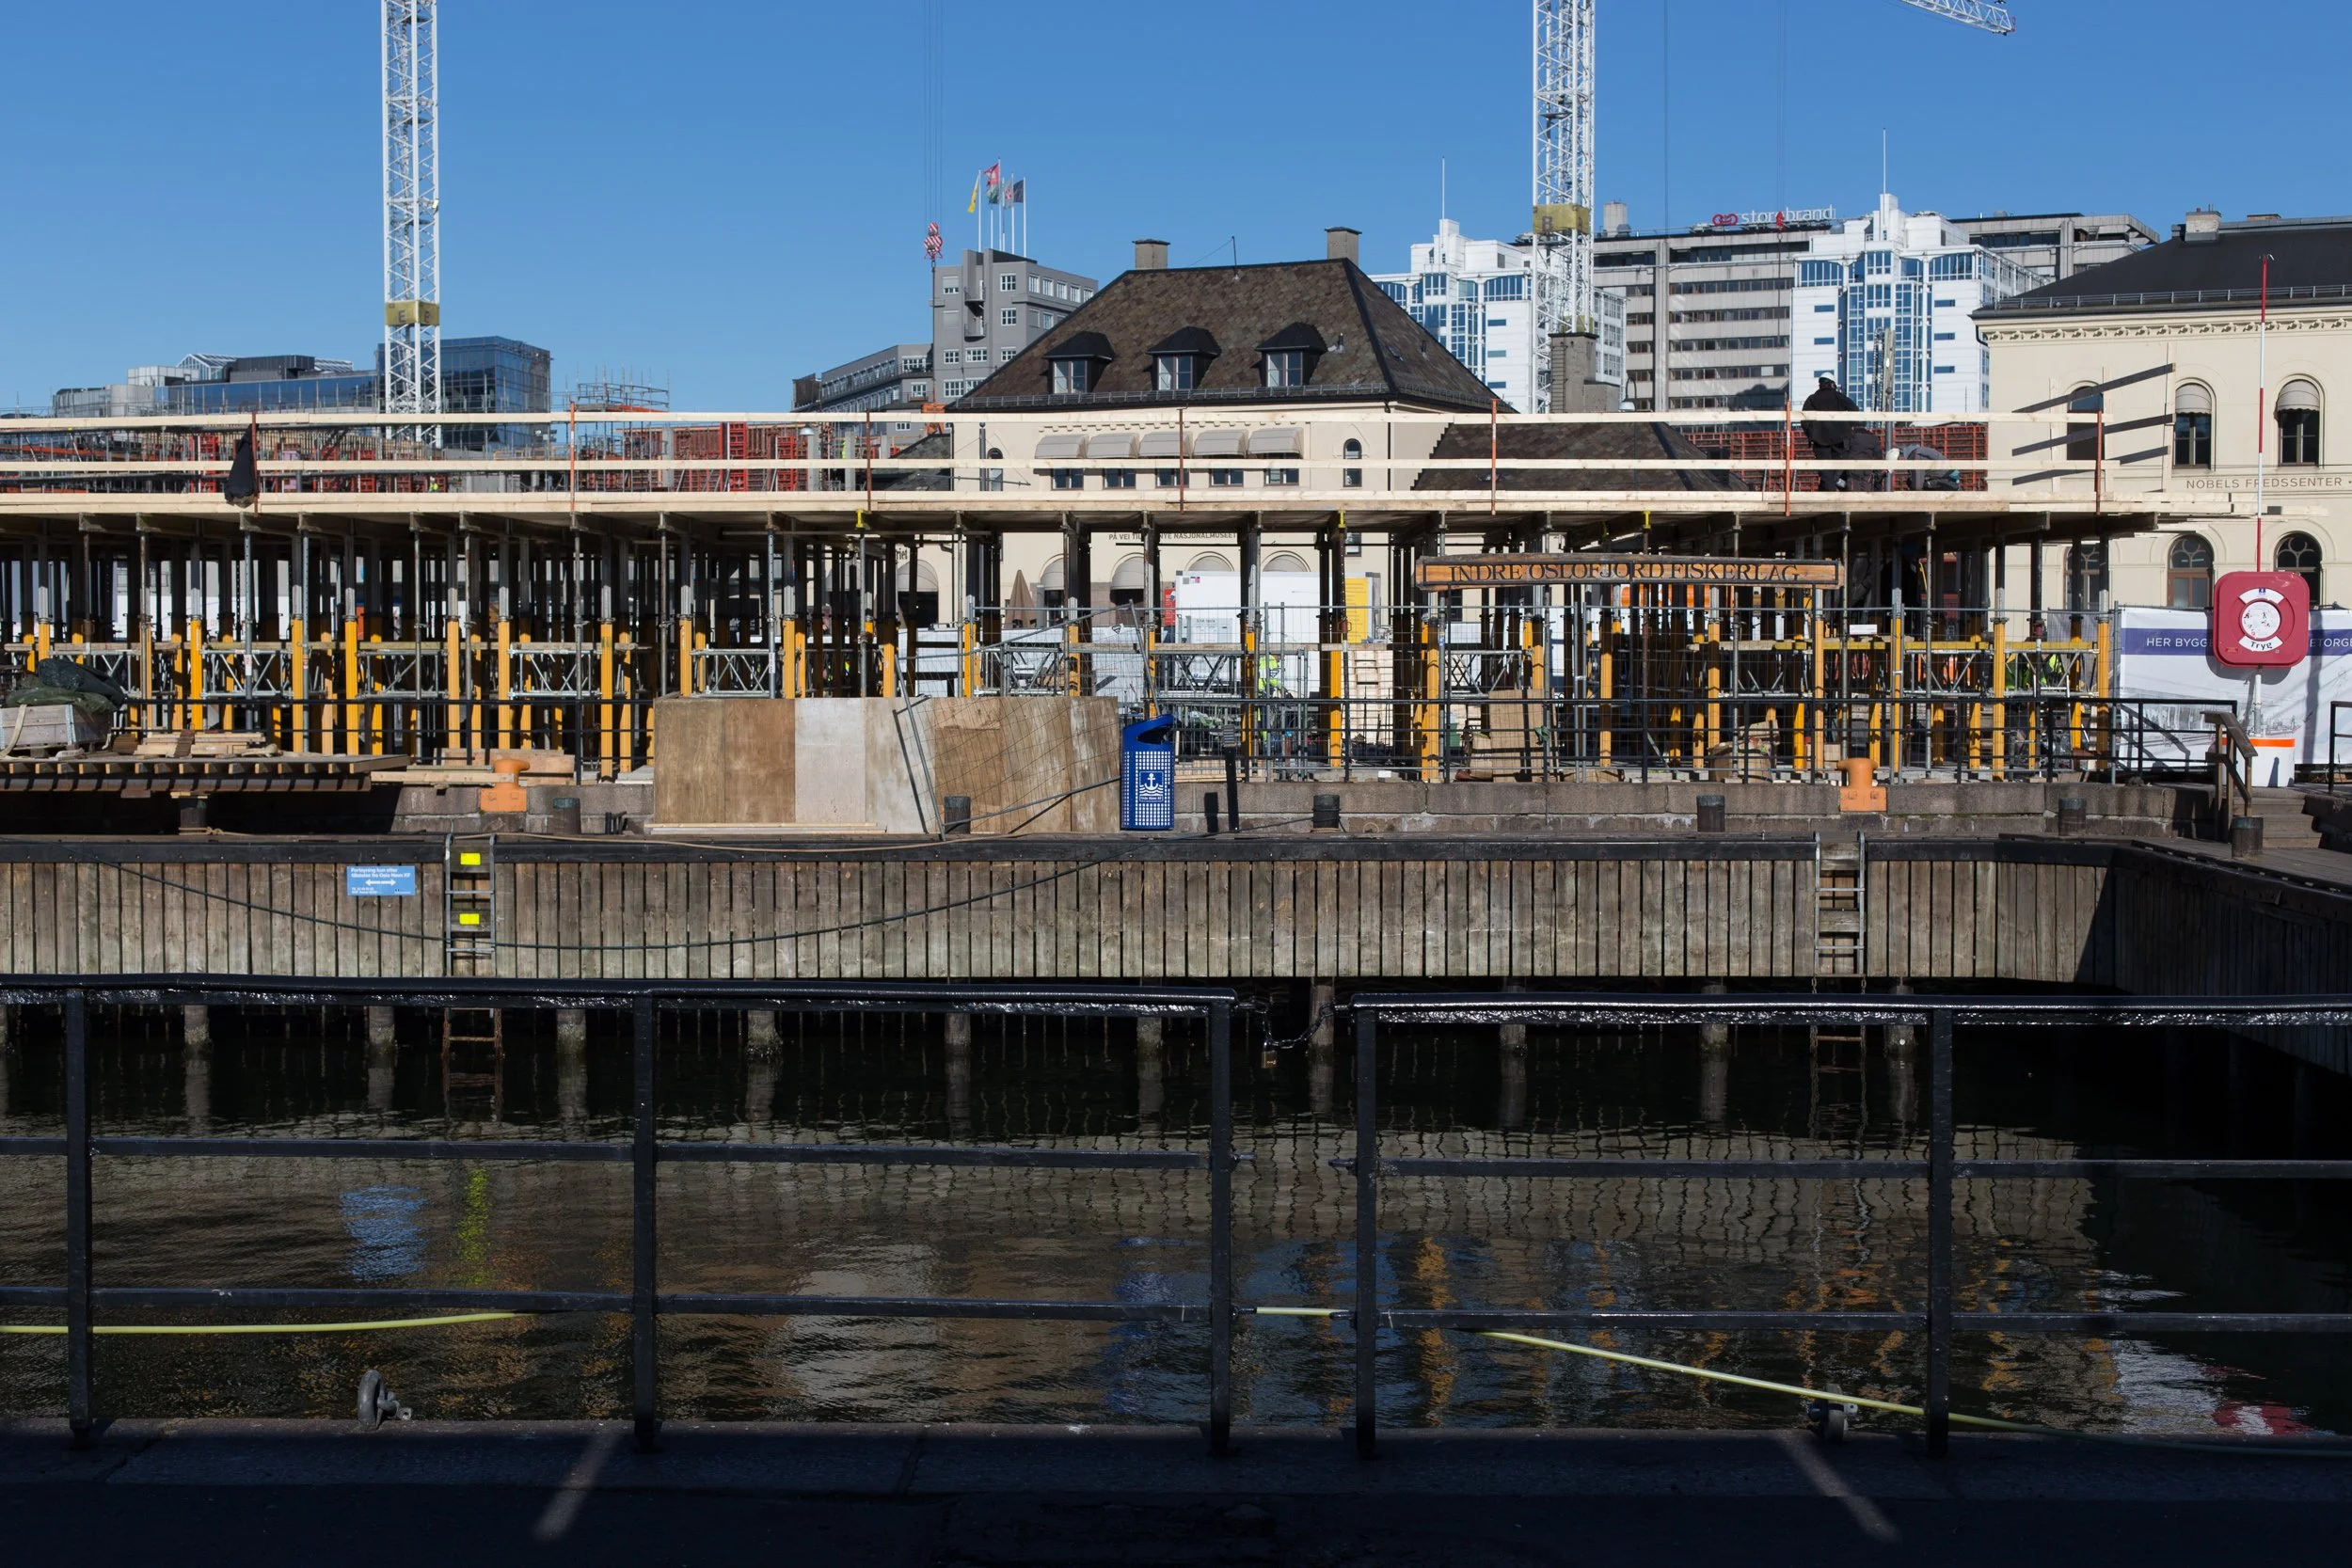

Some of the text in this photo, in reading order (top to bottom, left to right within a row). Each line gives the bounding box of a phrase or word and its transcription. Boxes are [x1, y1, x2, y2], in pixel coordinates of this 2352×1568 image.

[1741, 204, 1833, 224] storbrand
[398, 309, 405, 323] E
[2185, 477, 2343, 489] NOBELS FREDSSENTER
[1449, 562, 1799, 582] INDRE OSLOFJORD FISKERLAG
[2146, 637, 2171, 647] HER
[2250, 641, 2273, 651] Tryg
